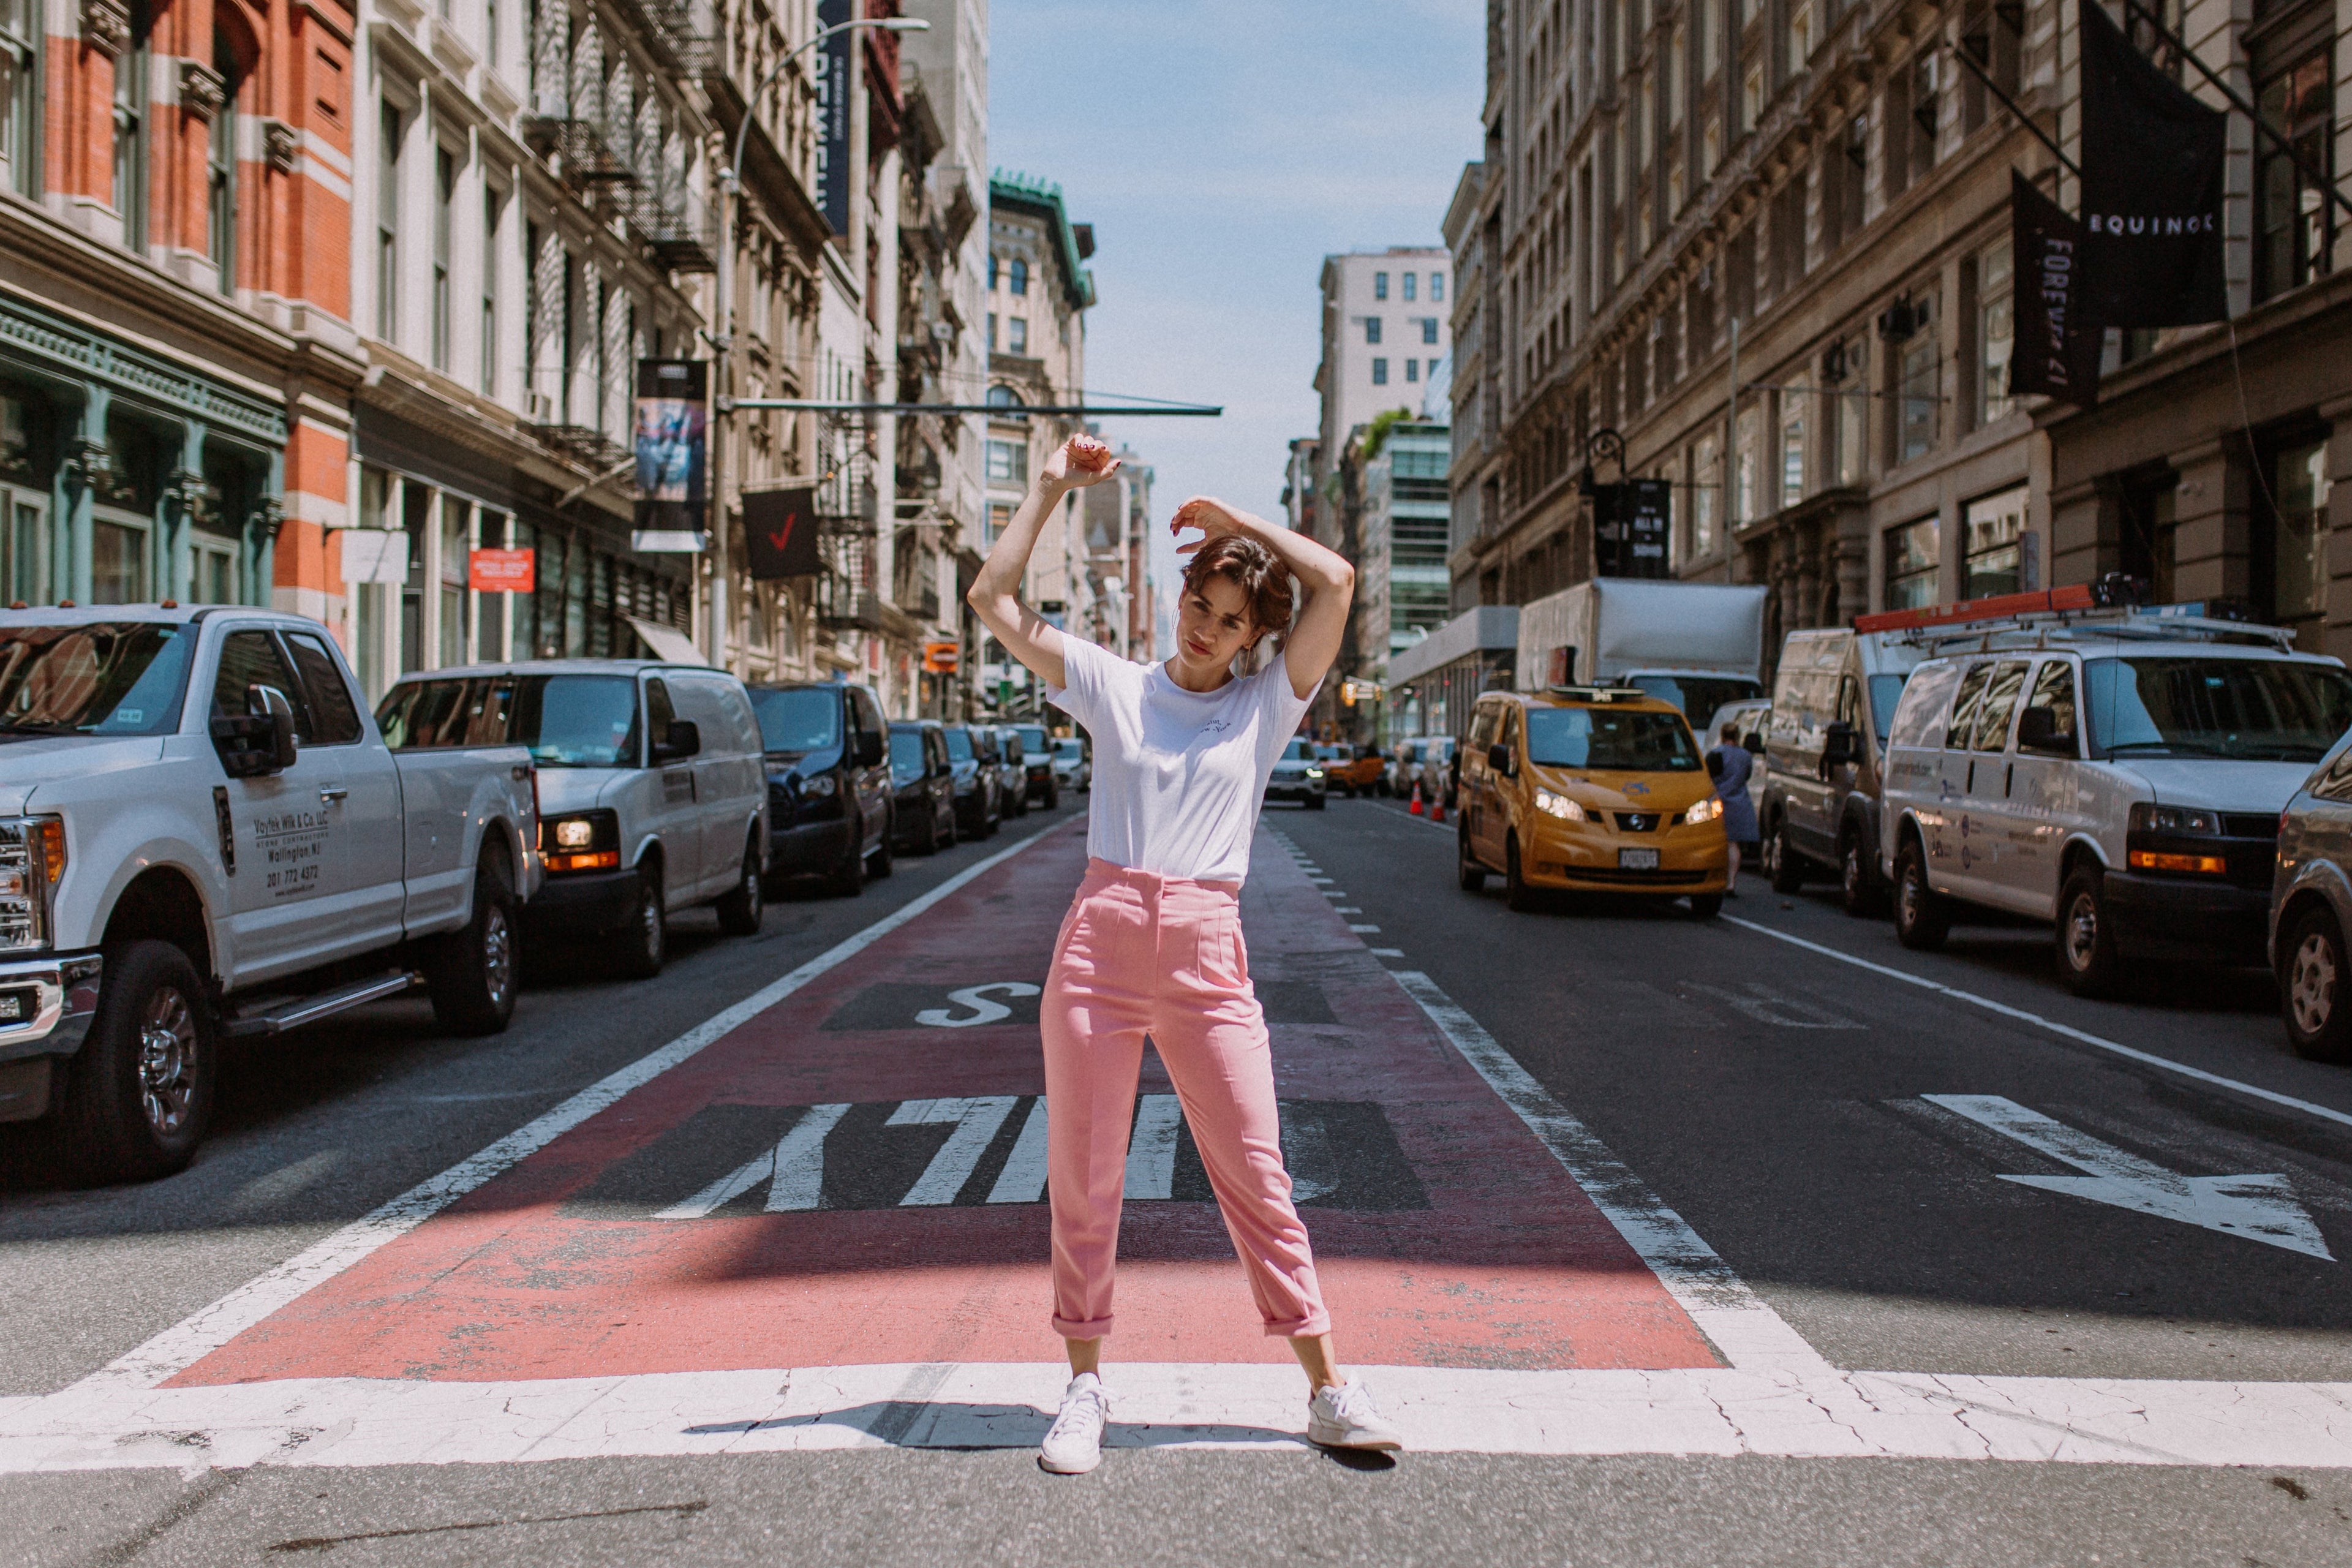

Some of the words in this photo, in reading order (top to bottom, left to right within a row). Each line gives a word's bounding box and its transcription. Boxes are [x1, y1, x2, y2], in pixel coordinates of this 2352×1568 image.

[297, 813, 301, 828] &
[316, 810, 328, 825] LLC
[267, 872, 280, 888] 201
[284, 869, 298, 885] 772
